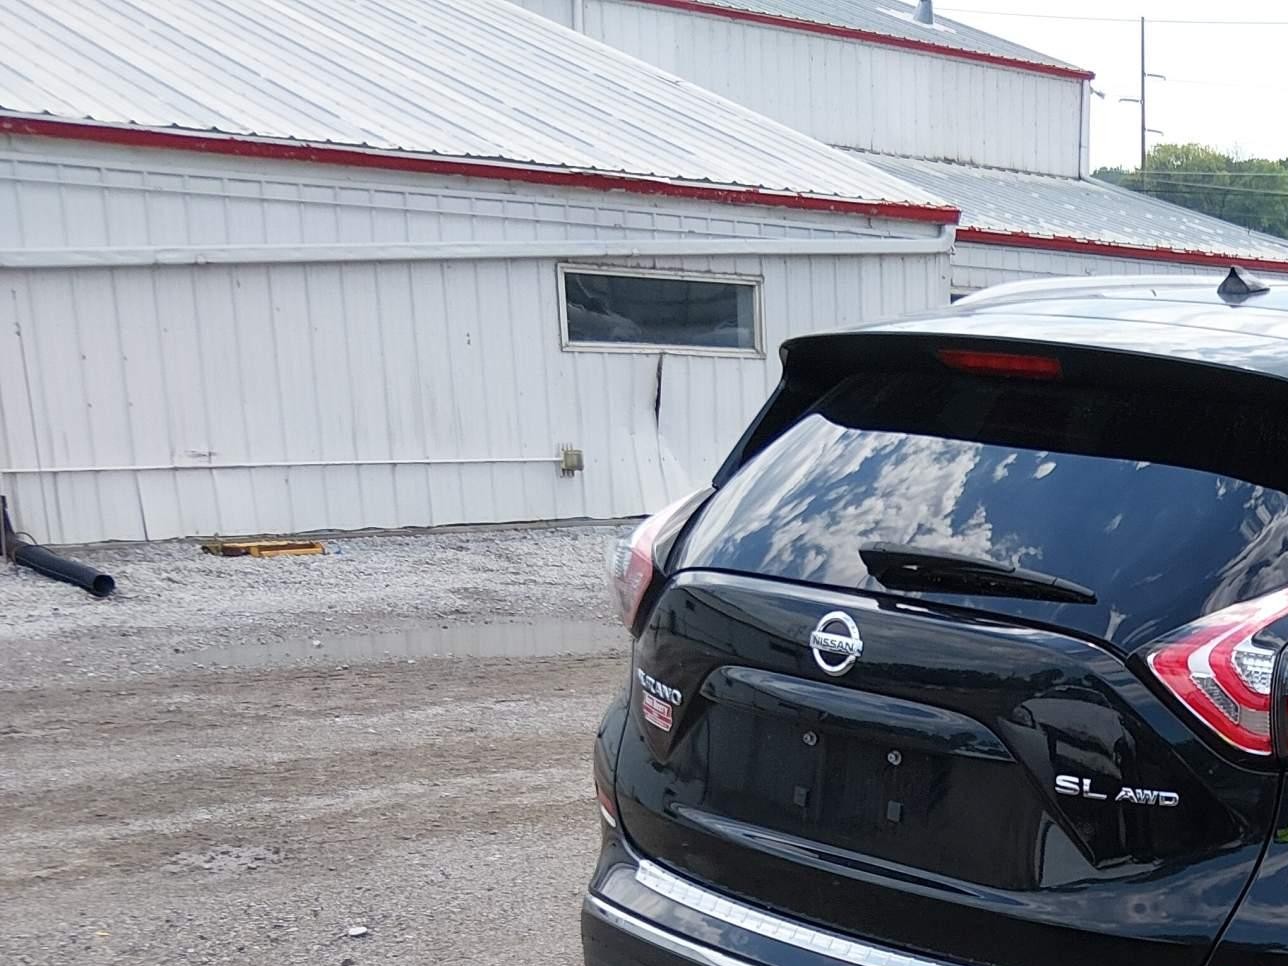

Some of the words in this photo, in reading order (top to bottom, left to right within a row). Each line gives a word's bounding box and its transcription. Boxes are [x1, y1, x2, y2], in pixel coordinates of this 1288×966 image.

[812, 633, 855, 653] NISSAN
[1054, 774, 1107, 800] SL
[1115, 787, 1180, 807] AWD
